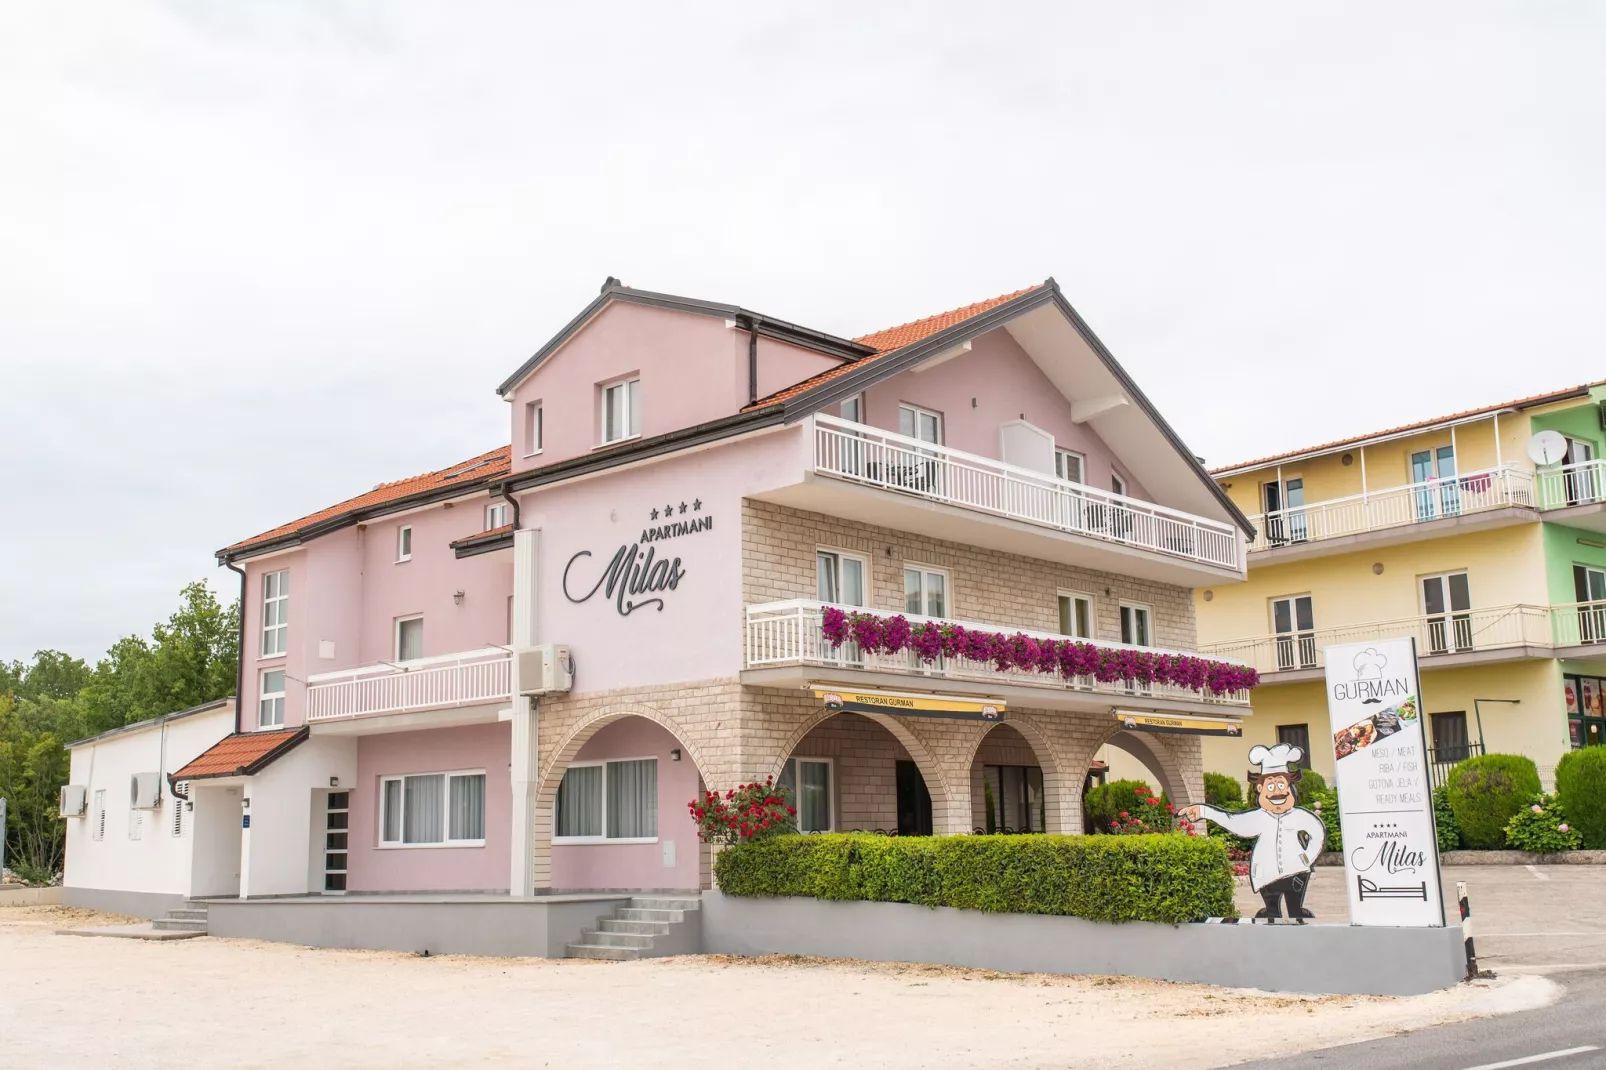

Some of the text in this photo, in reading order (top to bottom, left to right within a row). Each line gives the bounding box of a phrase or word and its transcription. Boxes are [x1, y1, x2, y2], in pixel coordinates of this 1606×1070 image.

[640, 516, 712, 544] APARTMANI
[563, 543, 686, 616] Milas
[1334, 678, 1408, 701] GURMAN
[856, 696, 914, 708] RESTORAN GURMAN
[1372, 748, 1388, 758] MESO
[1398, 746, 1415, 757] MEAT
[1402, 761, 1418, 772] FISH
[1368, 778, 1394, 790] GOTOVA
[1376, 792, 1422, 804] READY MEALS
[1366, 831, 1408, 839] APARTMANI
[1351, 840, 1426, 874] Milas
